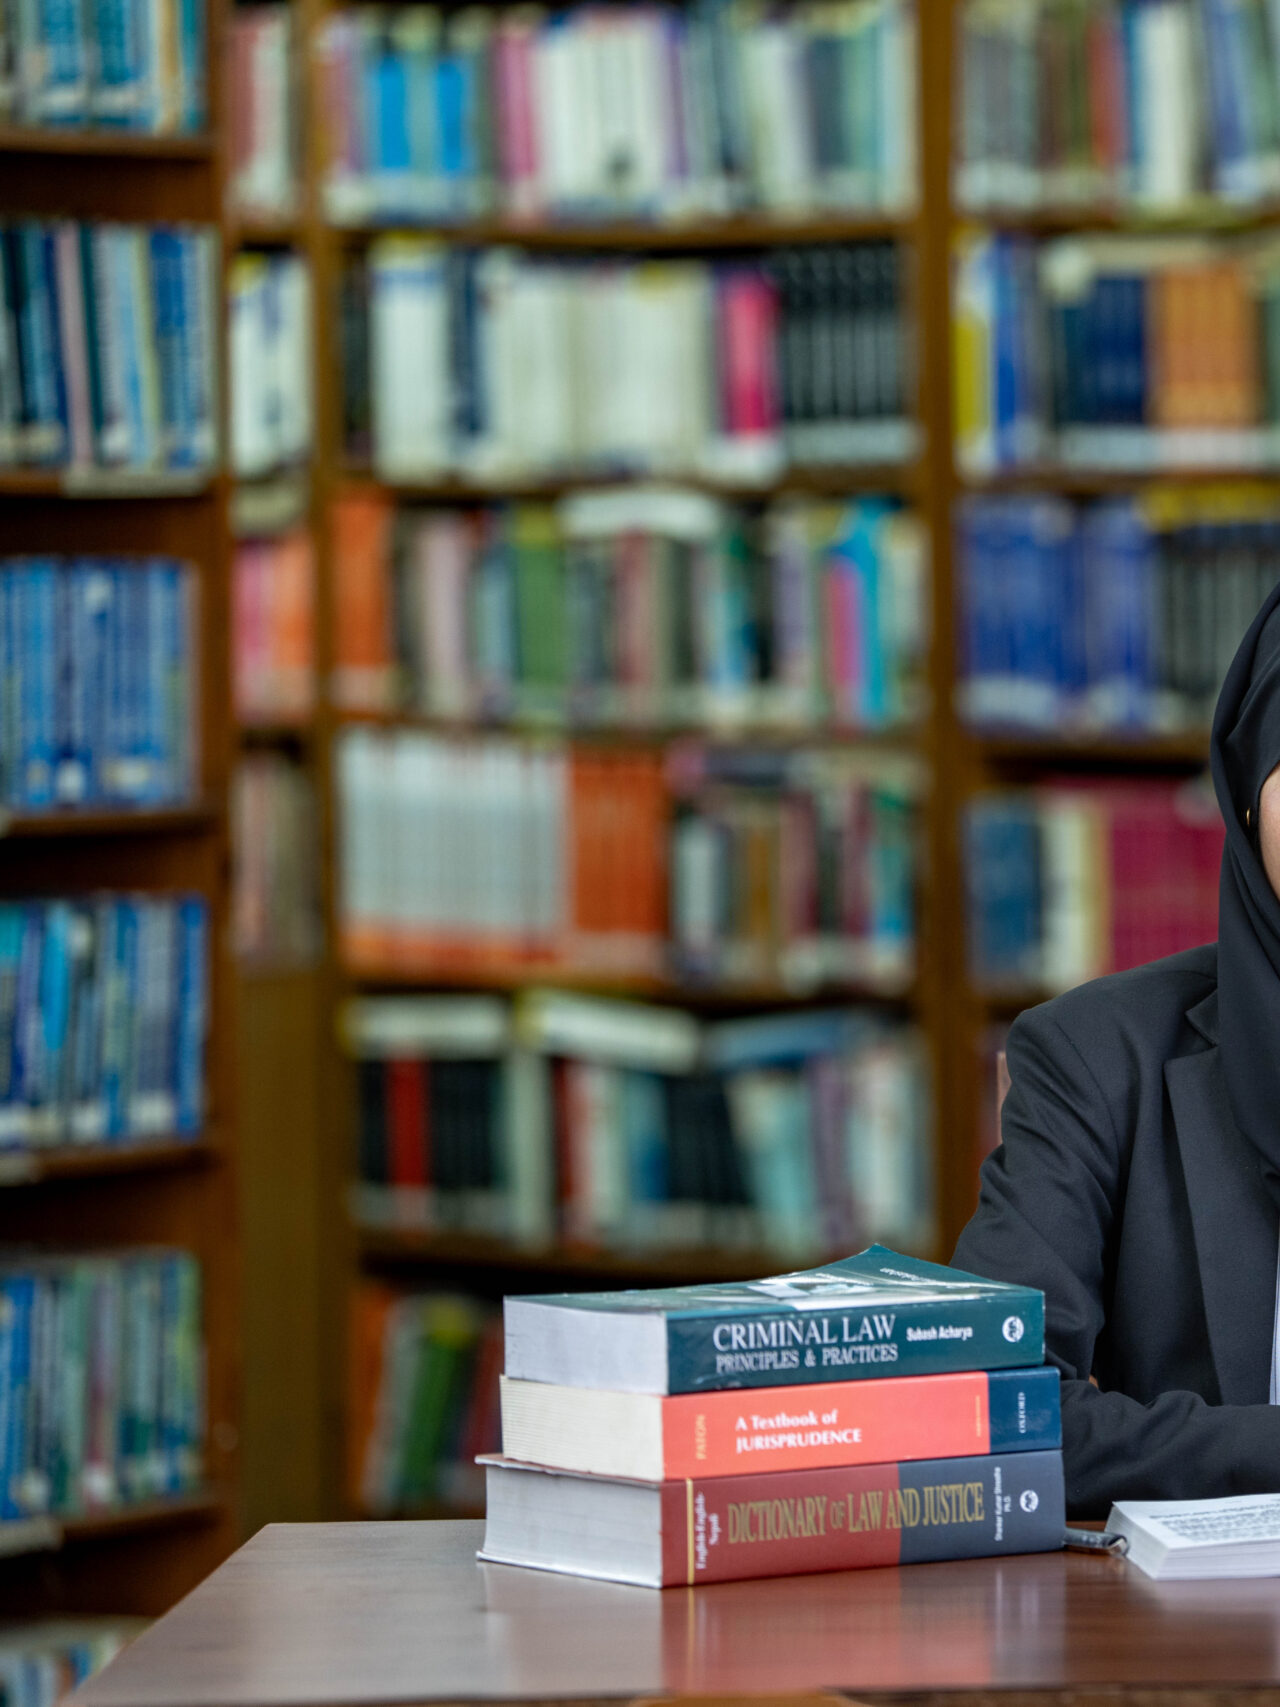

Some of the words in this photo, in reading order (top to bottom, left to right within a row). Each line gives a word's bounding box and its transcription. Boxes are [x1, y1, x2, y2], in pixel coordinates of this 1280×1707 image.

[713, 1318, 838, 1351] CRIMINAL
[842, 1314, 896, 1343] LAW
[906, 1326, 937, 1341] Subash
[939, 1325, 973, 1341] Acharya
[716, 1350, 799, 1373] PRINCIPLES
[804, 1348, 816, 1367] &
[822, 1343, 898, 1366] PRACTICES
[736, 1417, 748, 1431] A
[750, 1410, 818, 1430] Textbook
[822, 1408, 838, 1424] of
[1018, 1392, 1026, 1433] OXFORD
[736, 1428, 862, 1454] JURISPRUDENCE
[728, 1496, 827, 1544] DICTIONARY
[847, 1491, 883, 1533] LAW
[885, 1487, 920, 1530] AND
[923, 1482, 985, 1526] JUSTICE
